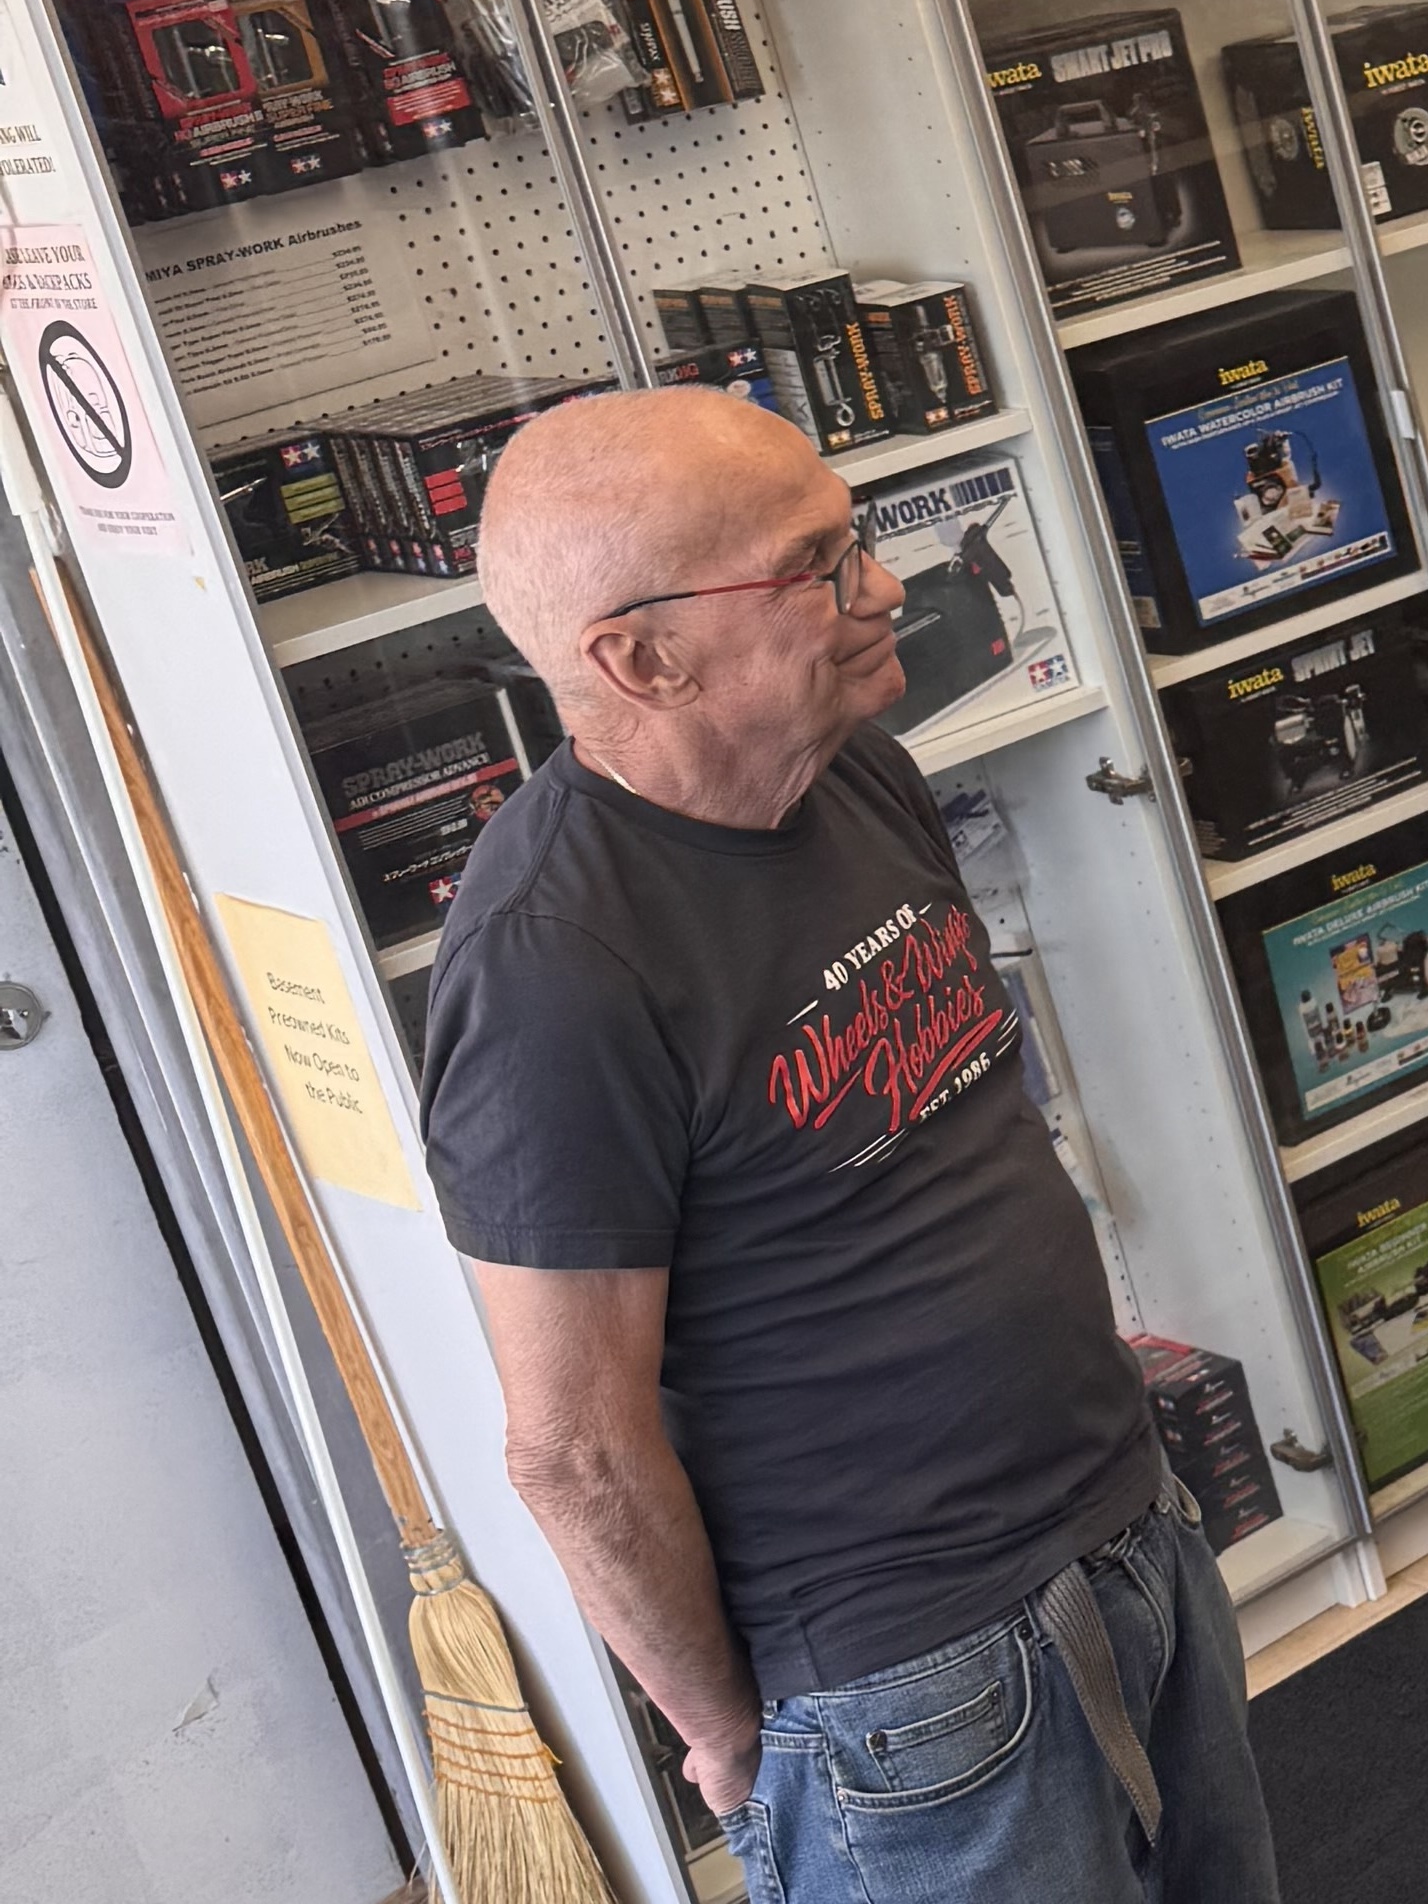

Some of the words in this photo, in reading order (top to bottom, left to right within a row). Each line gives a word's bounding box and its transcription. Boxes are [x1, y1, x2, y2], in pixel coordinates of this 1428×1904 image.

[1109, 38, 1140, 71] JET
[1140, 30, 1173, 63] PRO
[17, 123, 42, 142] WILL
[25, 246, 50, 265] LEAVE
[52, 244, 86, 263] YOUR
[186, 237, 285, 274] SPRAY-WORK
[288, 220, 363, 247] Airbrushes
[37, 271, 93, 292] BACKPACKS
[943, 294, 982, 396] SPRAY-WORK
[846, 321, 885, 421] SPRAY-WORK
[1218, 358, 1269, 387] iwata
[1161, 428, 1196, 449] IWATA
[1197, 400, 1273, 437] WATERCOLOR
[1275, 386, 1325, 415] AIRBRUSH
[1326, 377, 1344, 398] KIT
[1227, 664, 1284, 700] iwata
[342, 732, 486, 797] SPRAY-WORK
[367, 768, 441, 804] COMPRESSOR
[442, 752, 489, 778] ADVANCE
[1331, 862, 1377, 892] iwata
[1325, 910, 1364, 933] DELUXE
[1365, 891, 1412, 919] AIRBRUSH
[824, 967, 846, 992] 40
[845, 912, 899, 970] YEARS
[896, 903, 919, 930] OF
[267, 971, 325, 1006] Basement
[269, 1006, 323, 1045] Preowned
[327, 1022, 351, 1047] Kits
[769, 979, 888, 1130] Wheels
[881, 960, 912, 1010] &
[904, 904, 975, 995] Wings
[285, 1043, 311, 1070] Now
[313, 1052, 343, 1079] Open
[344, 1062, 361, 1082] to
[865, 975, 986, 1133] Hobbies
[954, 1052, 991, 1094] 1986
[306, 1080, 325, 1103] the
[326, 1087, 363, 1114] Public
[1357, 1196, 1401, 1228] iwata
